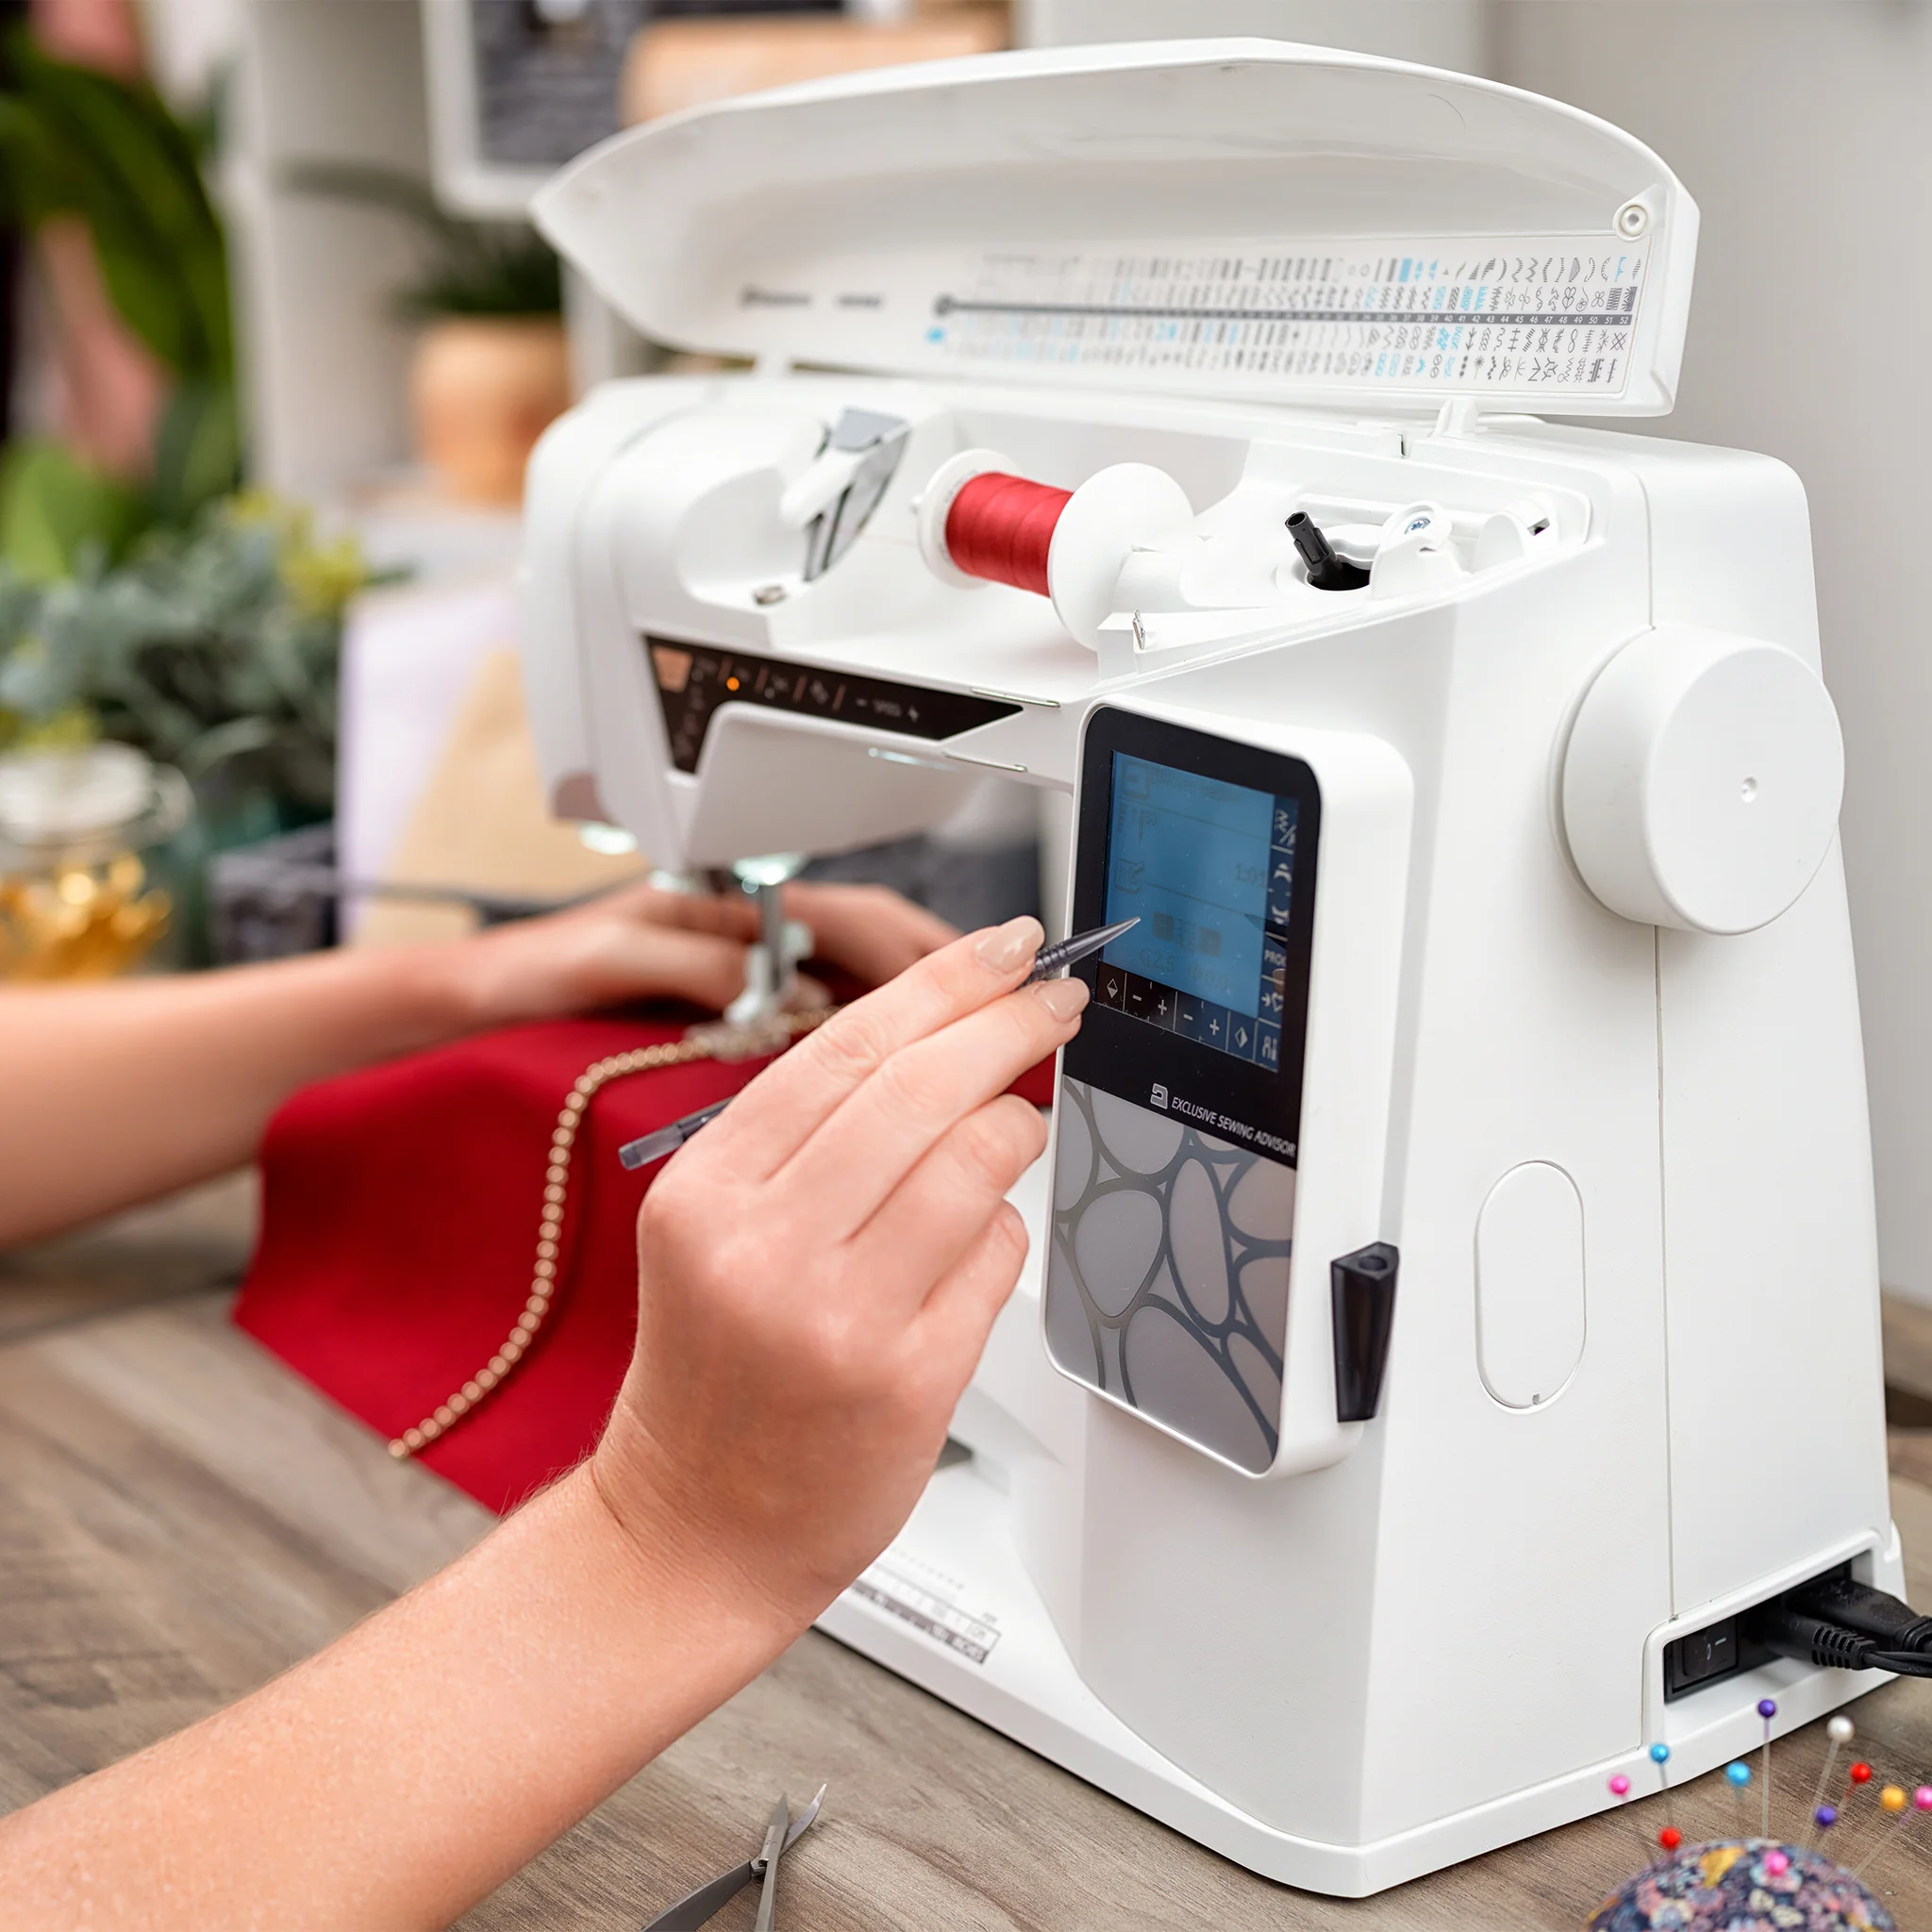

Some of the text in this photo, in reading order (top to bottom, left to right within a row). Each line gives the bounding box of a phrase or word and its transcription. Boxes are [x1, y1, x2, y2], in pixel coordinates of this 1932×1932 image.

[1444, 314, 1453, 323] 40
[1619, 316, 1628, 325] 52
[1172, 1096, 1297, 1158] EXCLUSIVE SEWING ADVISOR
